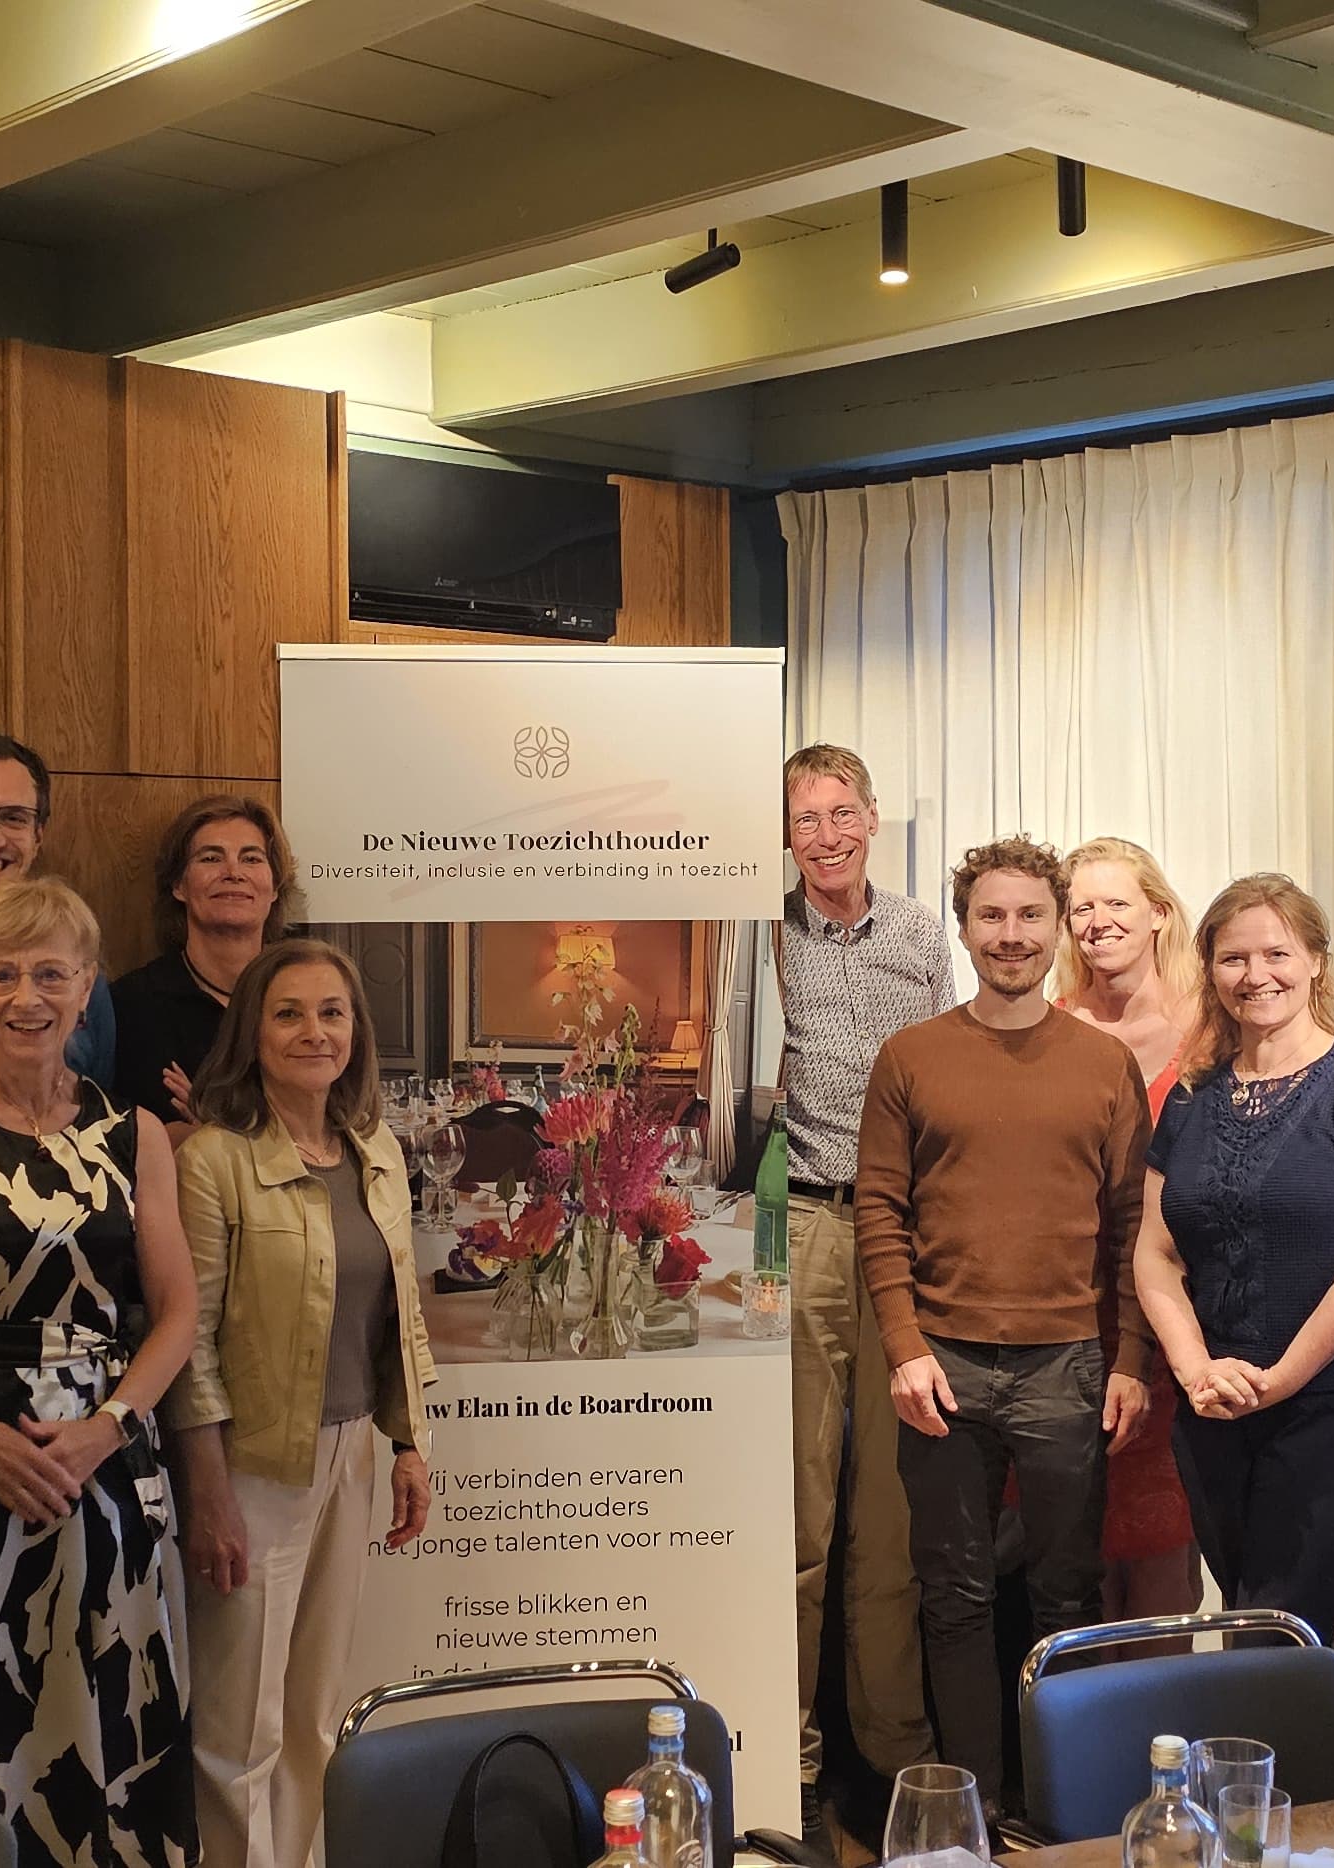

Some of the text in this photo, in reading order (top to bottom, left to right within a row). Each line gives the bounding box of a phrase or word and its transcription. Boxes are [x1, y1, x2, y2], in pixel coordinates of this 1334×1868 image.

[362, 830, 710, 852] De Nieuwe Toezichthouder
[310, 862, 758, 881] Diversiteit, inclusie en verbinding in toezicht
[456, 1396, 509, 1419] Elan
[516, 1395, 539, 1417] in
[545, 1394, 573, 1417] de
[578, 1391, 713, 1416] Boardroom
[453, 1467, 582, 1491] verbinden
[589, 1467, 683, 1488] ervaren
[443, 1496, 649, 1522] toezichthouders
[412, 1534, 487, 1560] jonge
[494, 1530, 599, 1552] talenten
[606, 1531, 662, 1548] voor
[669, 1529, 735, 1547] meer
[444, 1592, 647, 1618] frisse blikken en
[436, 1626, 657, 1649] nieuwe stemmen
